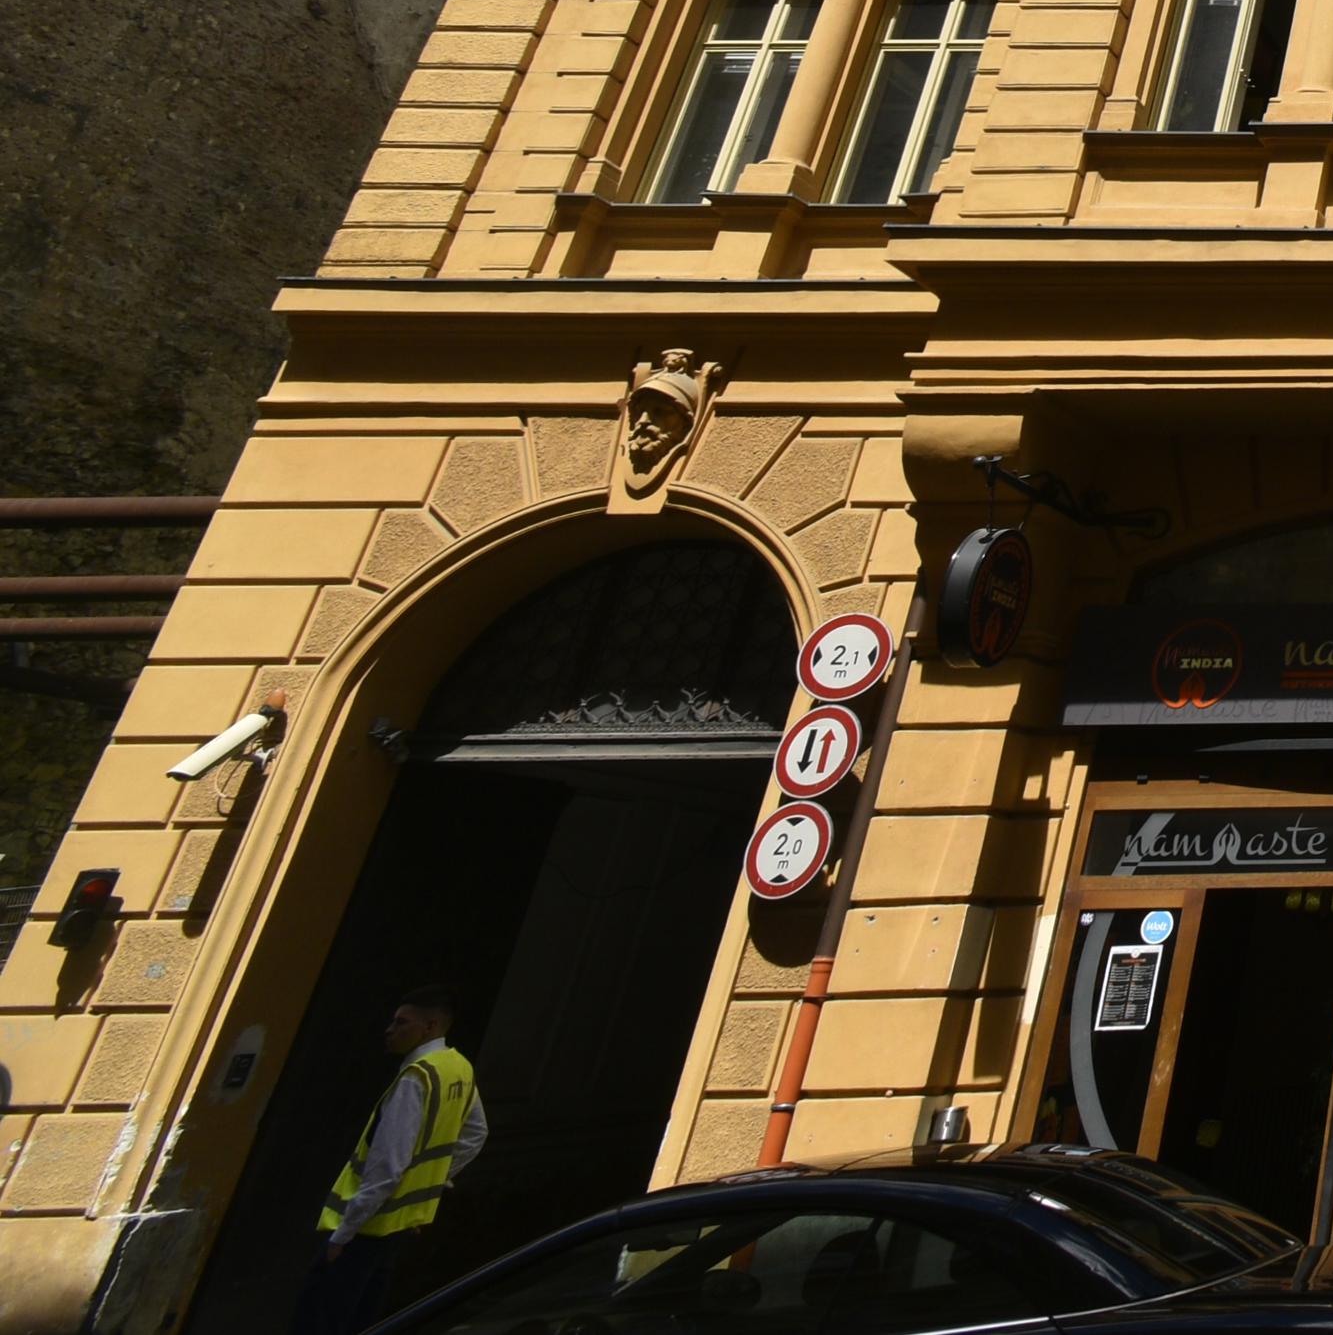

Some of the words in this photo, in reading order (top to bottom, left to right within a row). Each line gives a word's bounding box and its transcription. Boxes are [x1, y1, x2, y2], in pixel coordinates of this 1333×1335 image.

[830, 644, 861, 668] 2,1
[1179, 657, 1234, 670] INDIA
[833, 667, 848, 679] m
[772, 832, 804, 859] 2,0
[776, 859, 791, 870] m
[1146, 921, 1168, 932] Wolt
